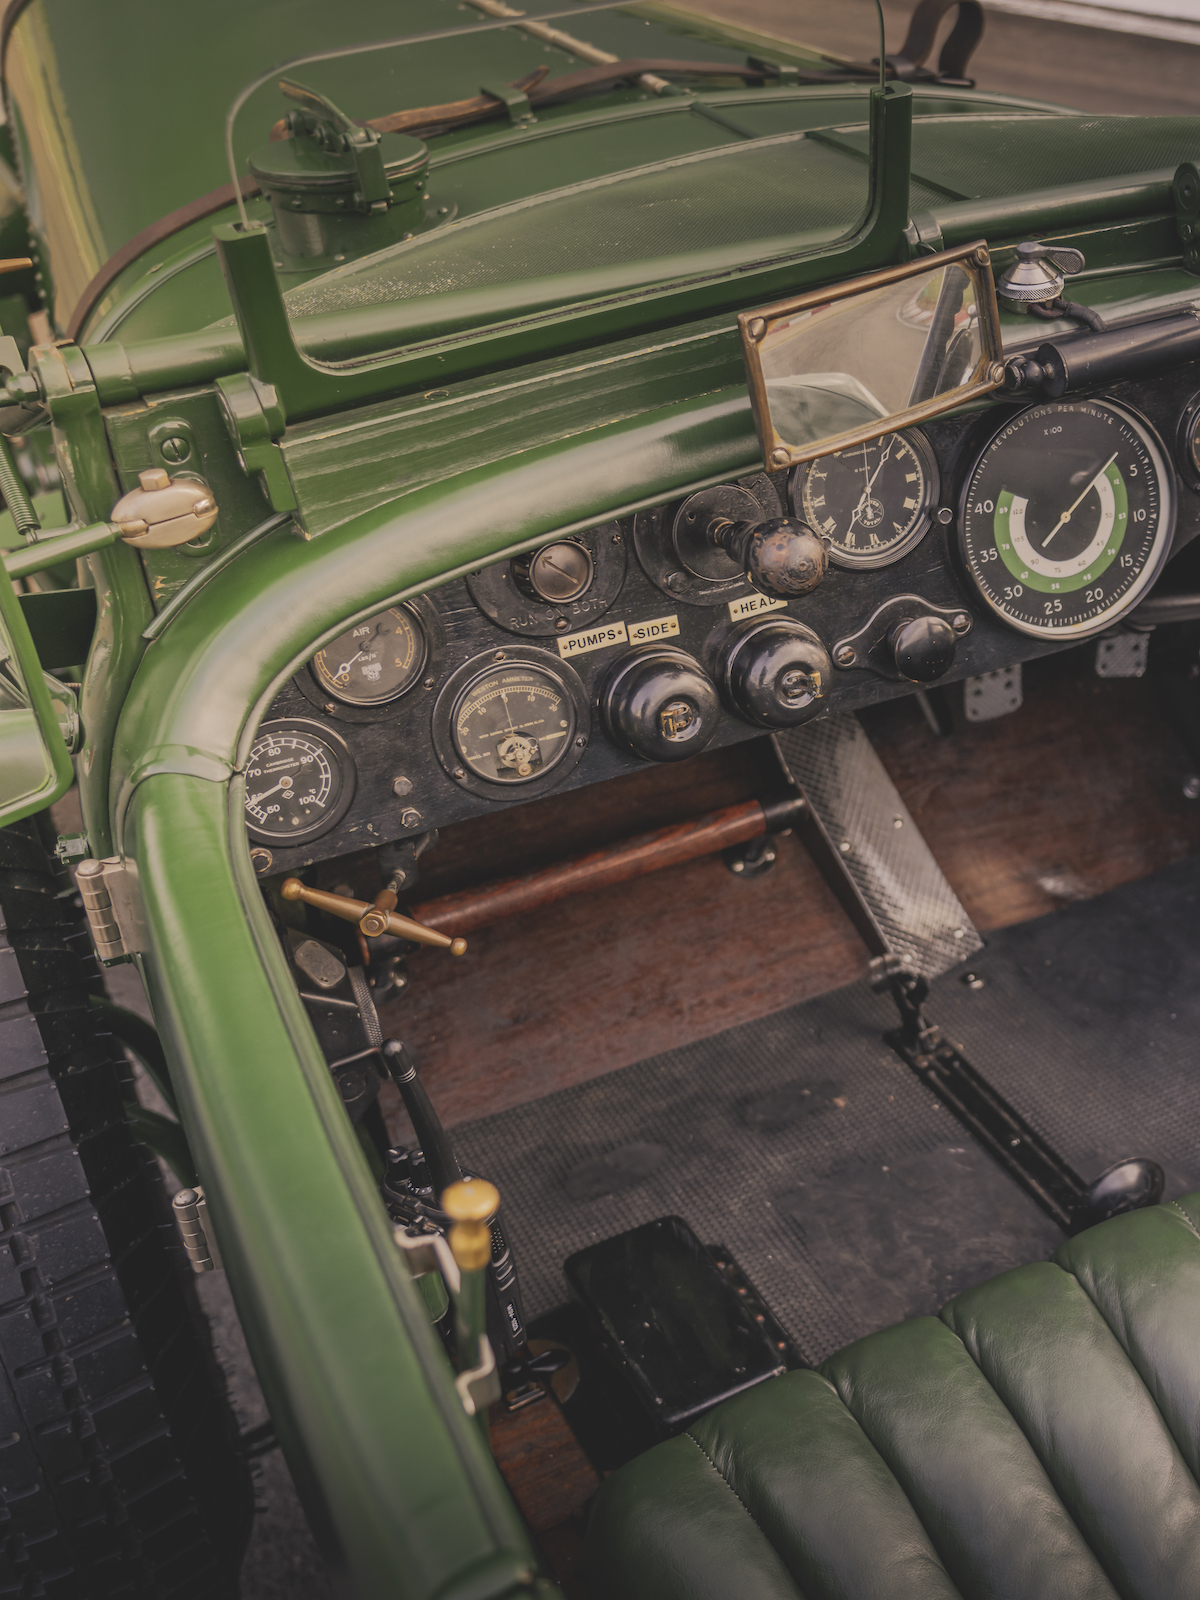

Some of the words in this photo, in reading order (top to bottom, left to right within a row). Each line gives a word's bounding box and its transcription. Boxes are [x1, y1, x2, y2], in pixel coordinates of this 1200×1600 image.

[991, 407, 1052, 451] REVOLUTIONS
[1080, 407, 1114, 425] MINUTE
[895, 448, 907, 460] II
[1129, 464, 1138, 477] 5
[905, 472, 918, 483] III
[974, 500, 994, 514] 40
[999, 506, 1008, 514] 89
[1118, 512, 1126, 520] 23
[1133, 509, 1147, 522] 10
[863, 517, 882, 526] TOTAL
[980, 548, 998, 563] 35
[1120, 554, 1133, 568] 15
[1020, 571, 1029, 579] 67
[1004, 584, 1023, 600] 30
[1085, 587, 1104, 603] 20
[1044, 599, 1063, 615] 25
[509, 613, 539, 630] RUN
[572, 598, 609, 615] BOTH
[352, 626, 371, 638] AIR
[395, 626, 403, 635] 4
[637, 622, 670, 640] SIDE
[568, 629, 616, 651] PUMPS
[395, 658, 403, 668] 5
[341, 673, 350, 682] 0
[471, 680, 499, 697] WESTON
[502, 675, 534, 684] AMMETER
[477, 706, 487, 716] 10
[548, 702, 558, 712] 20
[267, 747, 282, 757] 80
[265, 757, 295, 768] CAMBRIDGE
[300, 755, 314, 765] 90
[248, 768, 262, 778] 70
[263, 761, 300, 774] THERMOMETER
[299, 794, 316, 805] 100
[266, 804, 281, 814] 50
